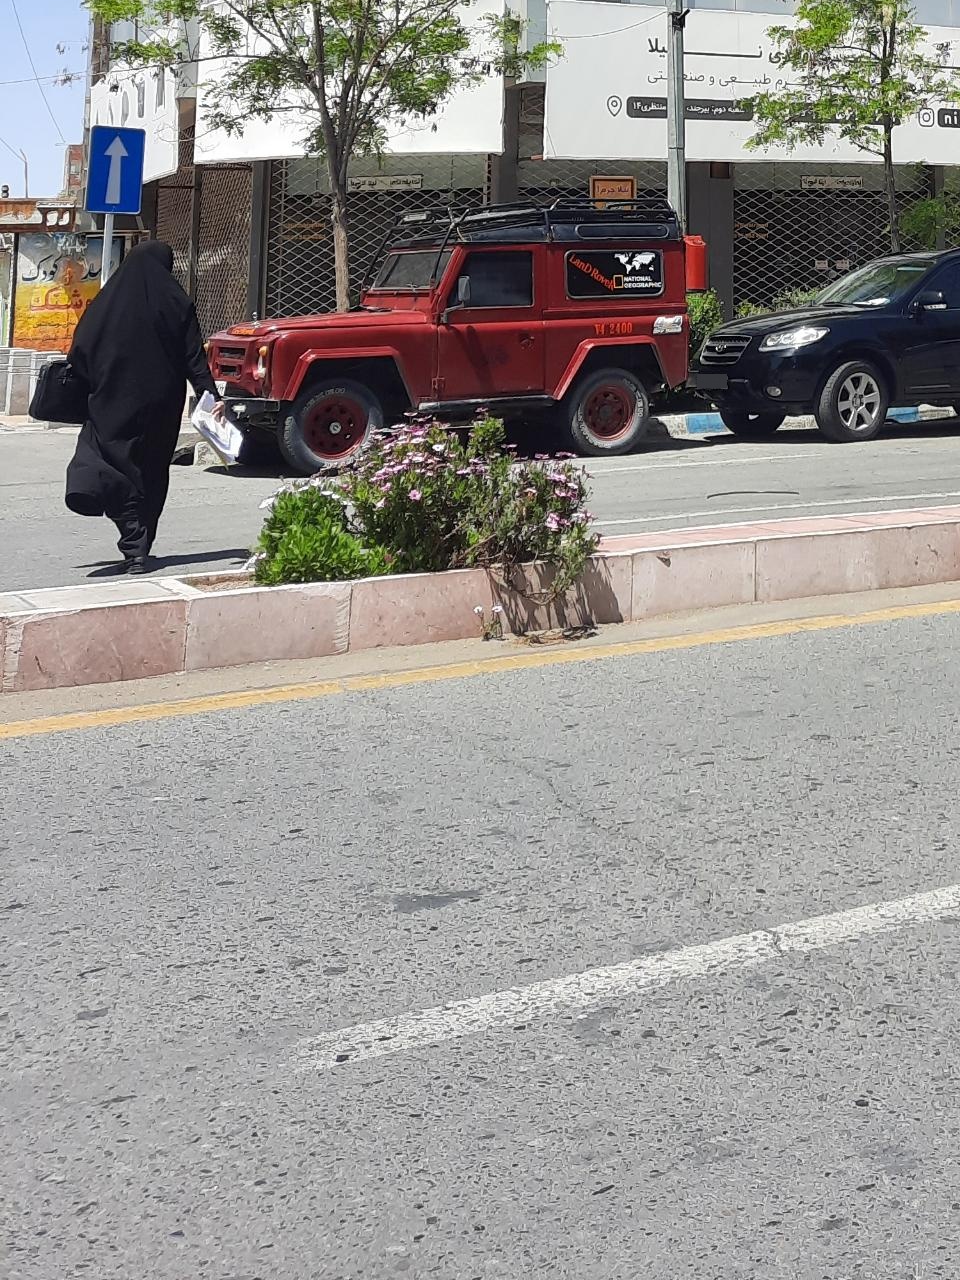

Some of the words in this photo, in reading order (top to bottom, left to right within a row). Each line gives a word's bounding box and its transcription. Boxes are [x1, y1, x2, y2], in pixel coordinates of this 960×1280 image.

[709, 76, 716, 87] و
[719, 73, 772, 88] طبیعی
[623, 281, 662, 289] GEOGRAPHIC
